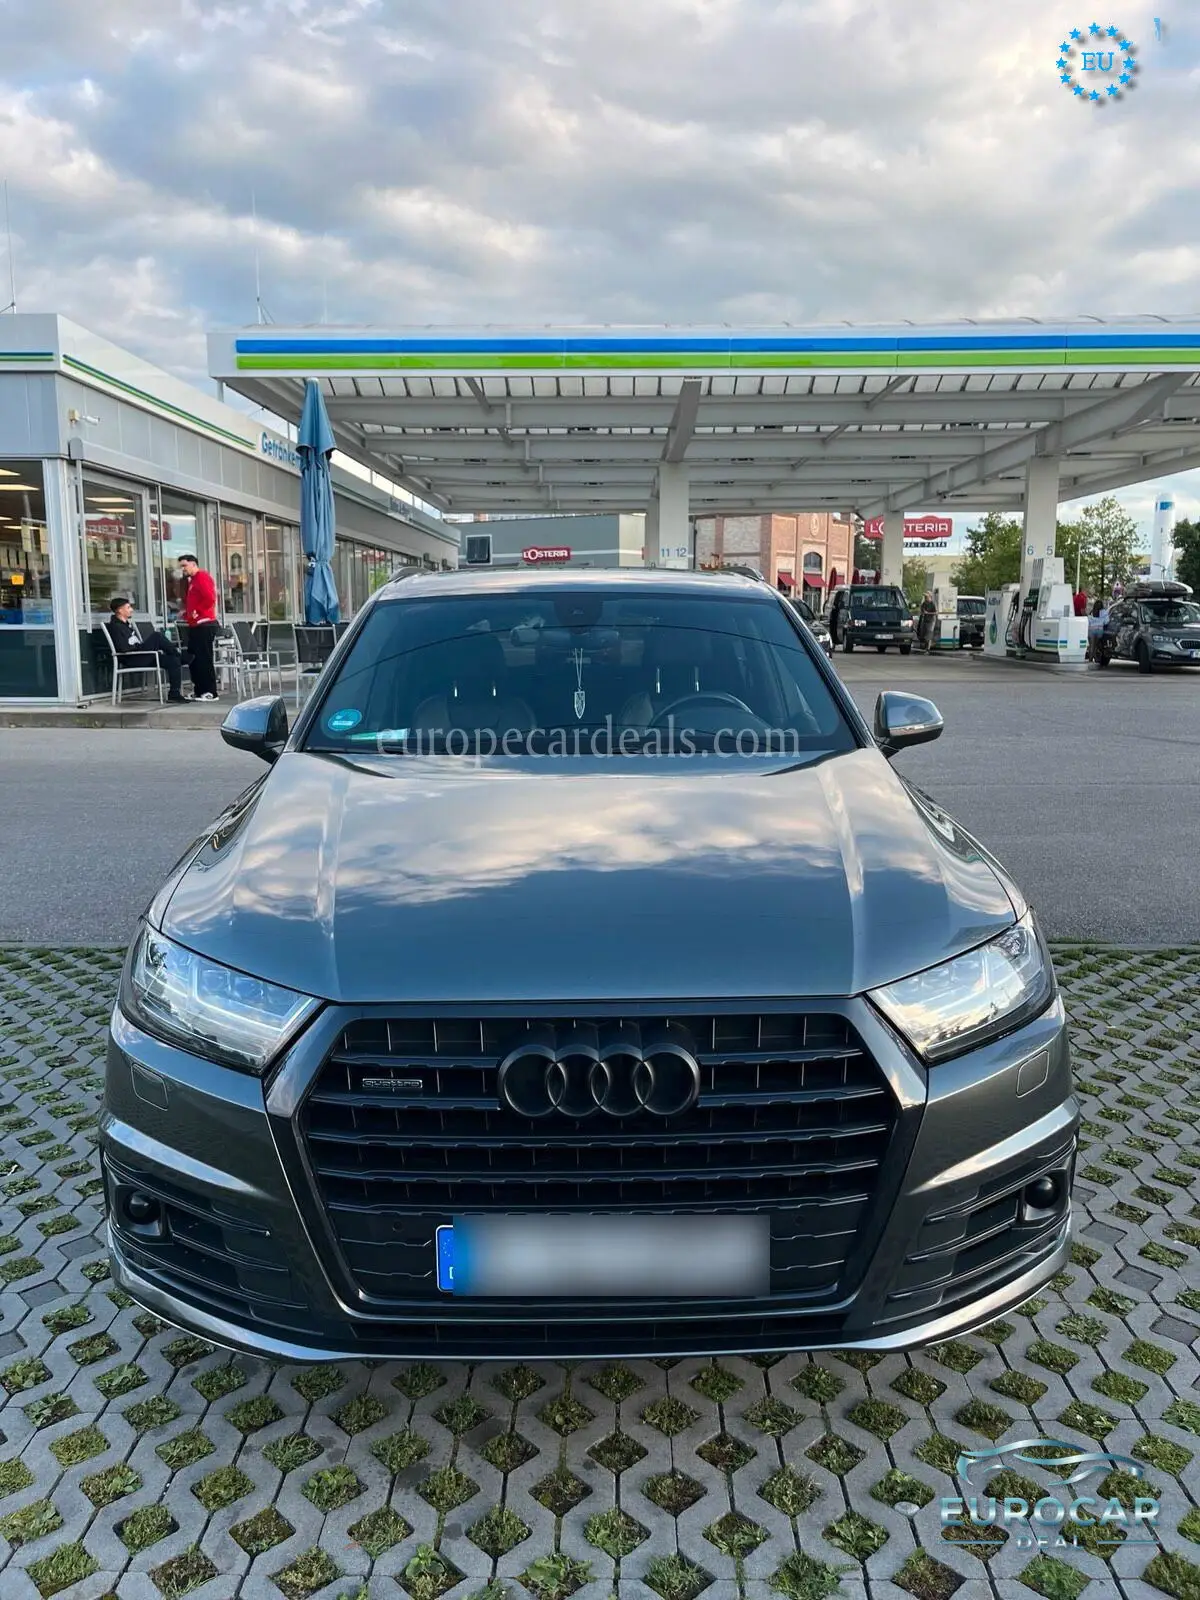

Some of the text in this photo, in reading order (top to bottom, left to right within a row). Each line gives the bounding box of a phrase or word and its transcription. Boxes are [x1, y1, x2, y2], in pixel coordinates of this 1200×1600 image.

[870, 521, 949, 535] L'TERIA
[661, 547, 687, 558] 11 12
[1027, 546, 1053, 555] 6 5
